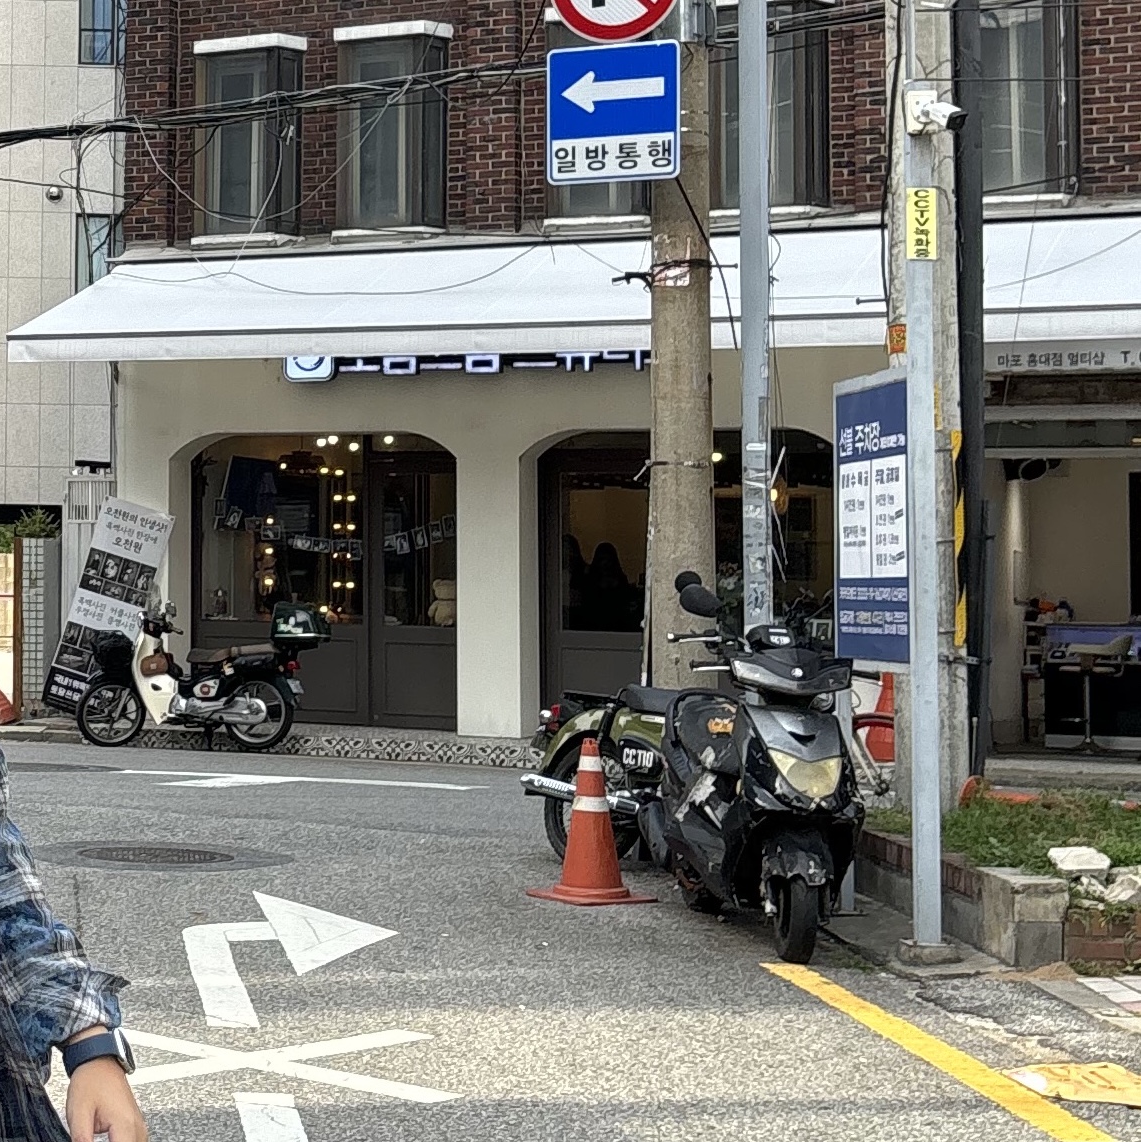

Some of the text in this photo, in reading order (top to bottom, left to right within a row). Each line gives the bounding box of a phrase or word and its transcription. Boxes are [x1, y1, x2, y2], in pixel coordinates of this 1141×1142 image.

[554, 139, 672, 174] 일방통행
[997, 352, 1023, 368] 마포
[854, 420, 881, 455] 주차장
[112, 536, 144, 554] 오천원
